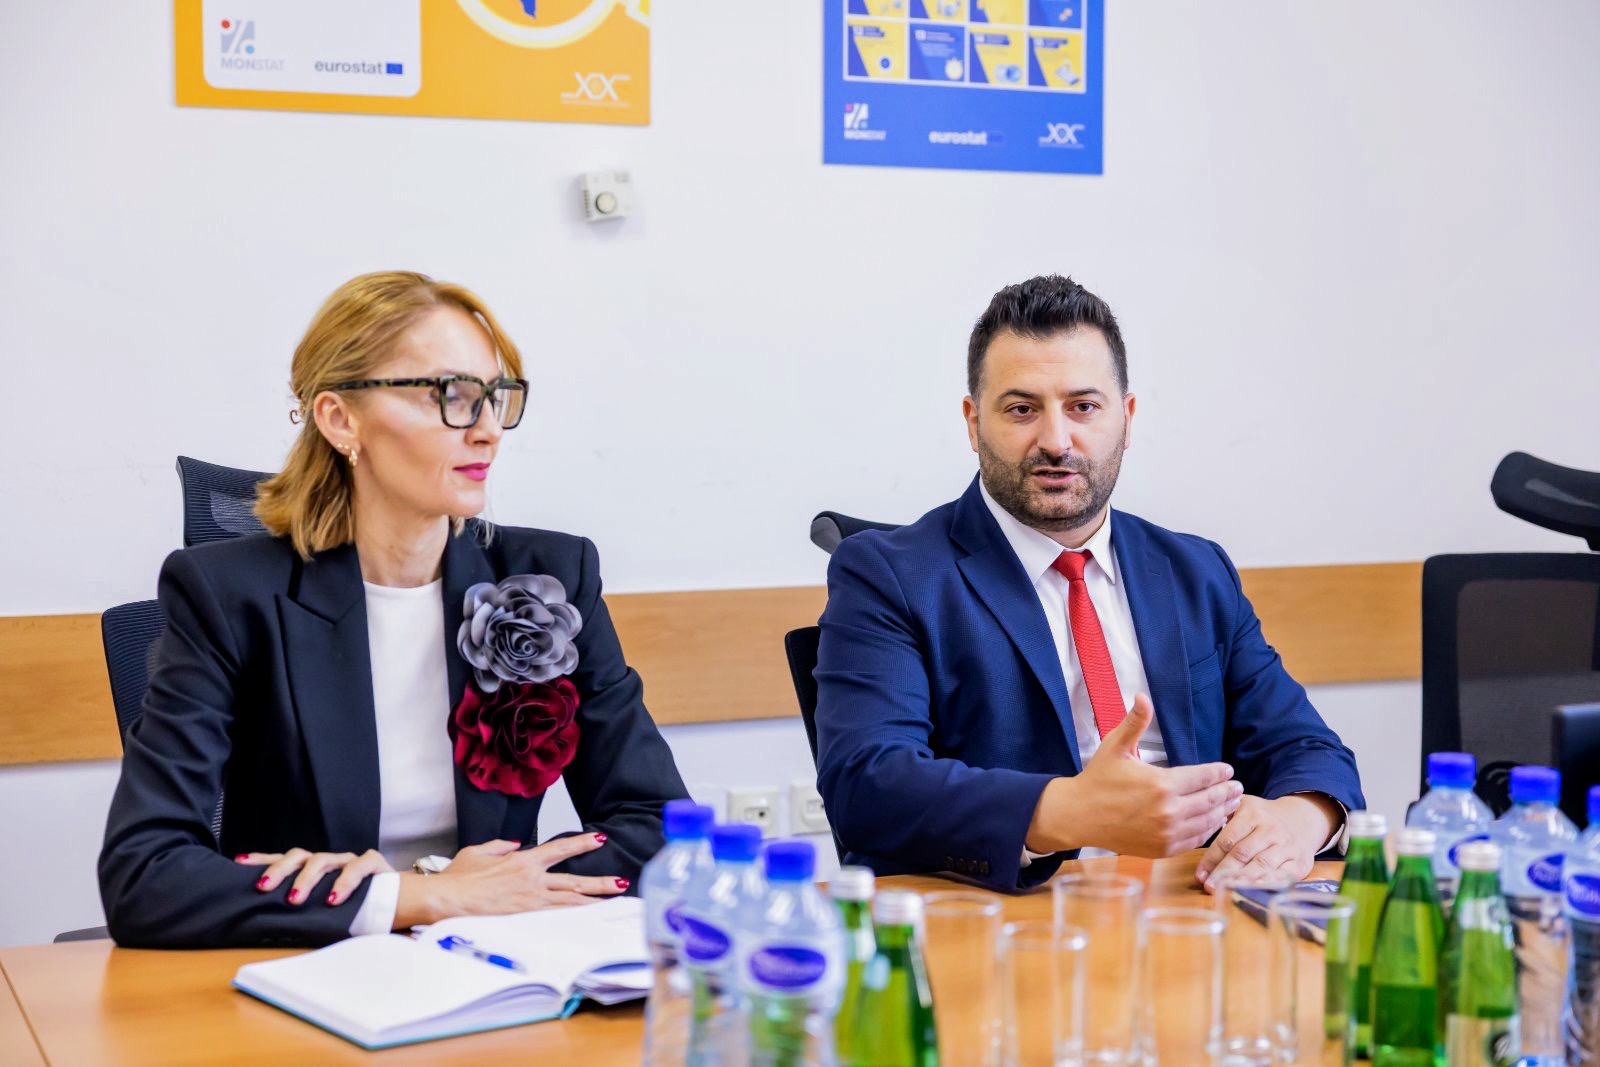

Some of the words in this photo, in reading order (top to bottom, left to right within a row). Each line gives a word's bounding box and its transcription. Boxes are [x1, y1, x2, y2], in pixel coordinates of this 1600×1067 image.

[221, 57, 284, 72] MONSTAT
[314, 60, 382, 75] eurostat
[929, 130, 988, 146] eurostat
